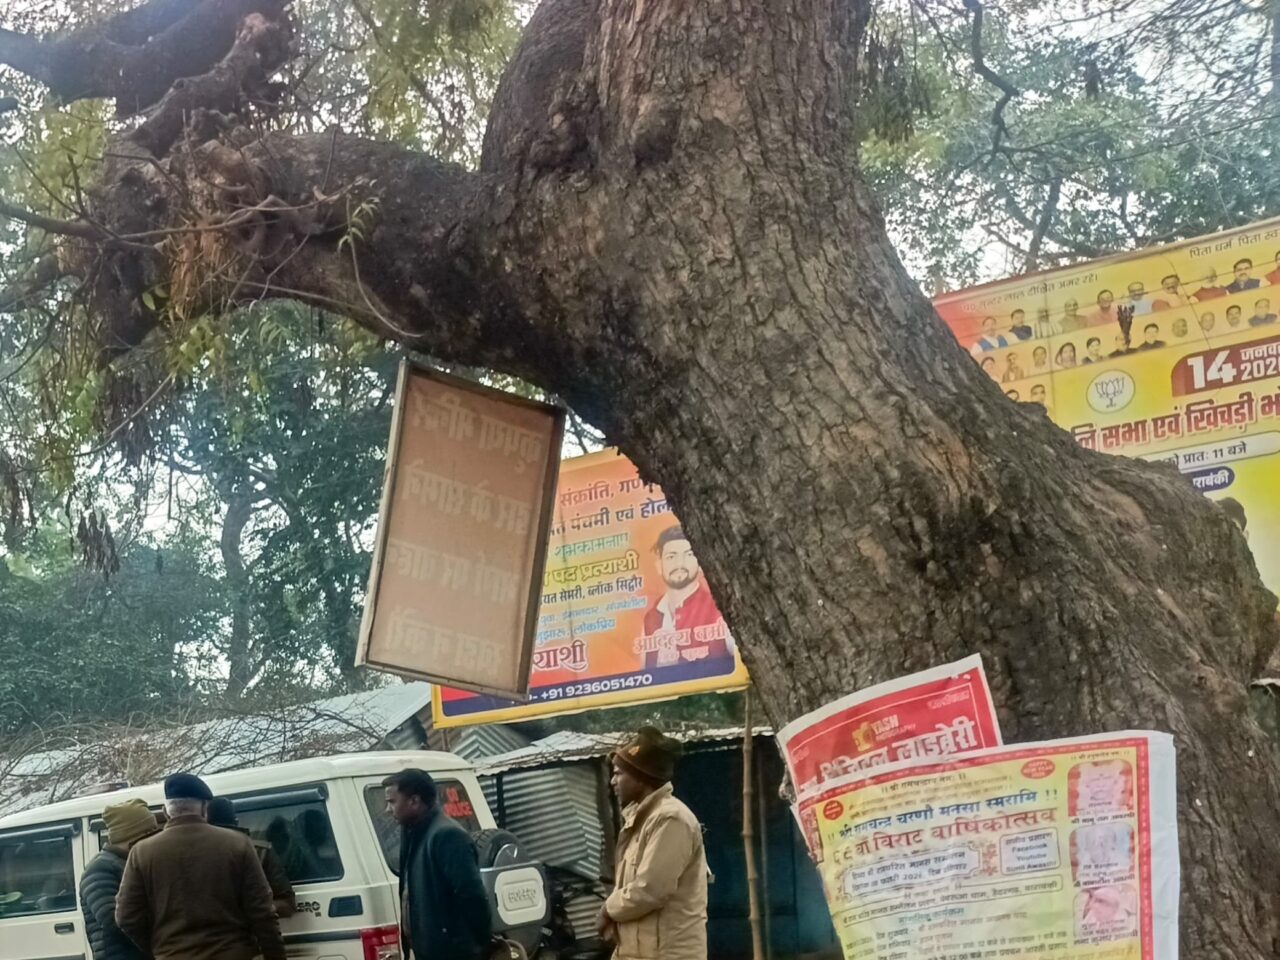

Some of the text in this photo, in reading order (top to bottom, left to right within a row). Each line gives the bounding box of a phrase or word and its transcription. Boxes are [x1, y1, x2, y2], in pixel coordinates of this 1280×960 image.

[1240, 342, 1280, 361] जनव
[1187, 350, 1237, 389] 14
[1100, 419, 1147, 448] सभा
[1151, 405, 1181, 438] एवं
[1185, 391, 1254, 432] खिचड़ी
[1212, 447, 1224, 458] 11
[1227, 441, 1247, 456] बजे
[619, 478, 646, 493] गण
[571, 507, 610, 532] पंचमी
[616, 504, 634, 522] एवं
[640, 498, 674, 518] होल
[552, 566, 578, 583] पद
[580, 549, 639, 581] प्रत्याशी
[541, 674, 653, 700] +91 9236051470
[939, 801, 981, 817] मनसा
[985, 788, 1038, 808] स्मरामि
[872, 831, 924, 851] विराट
